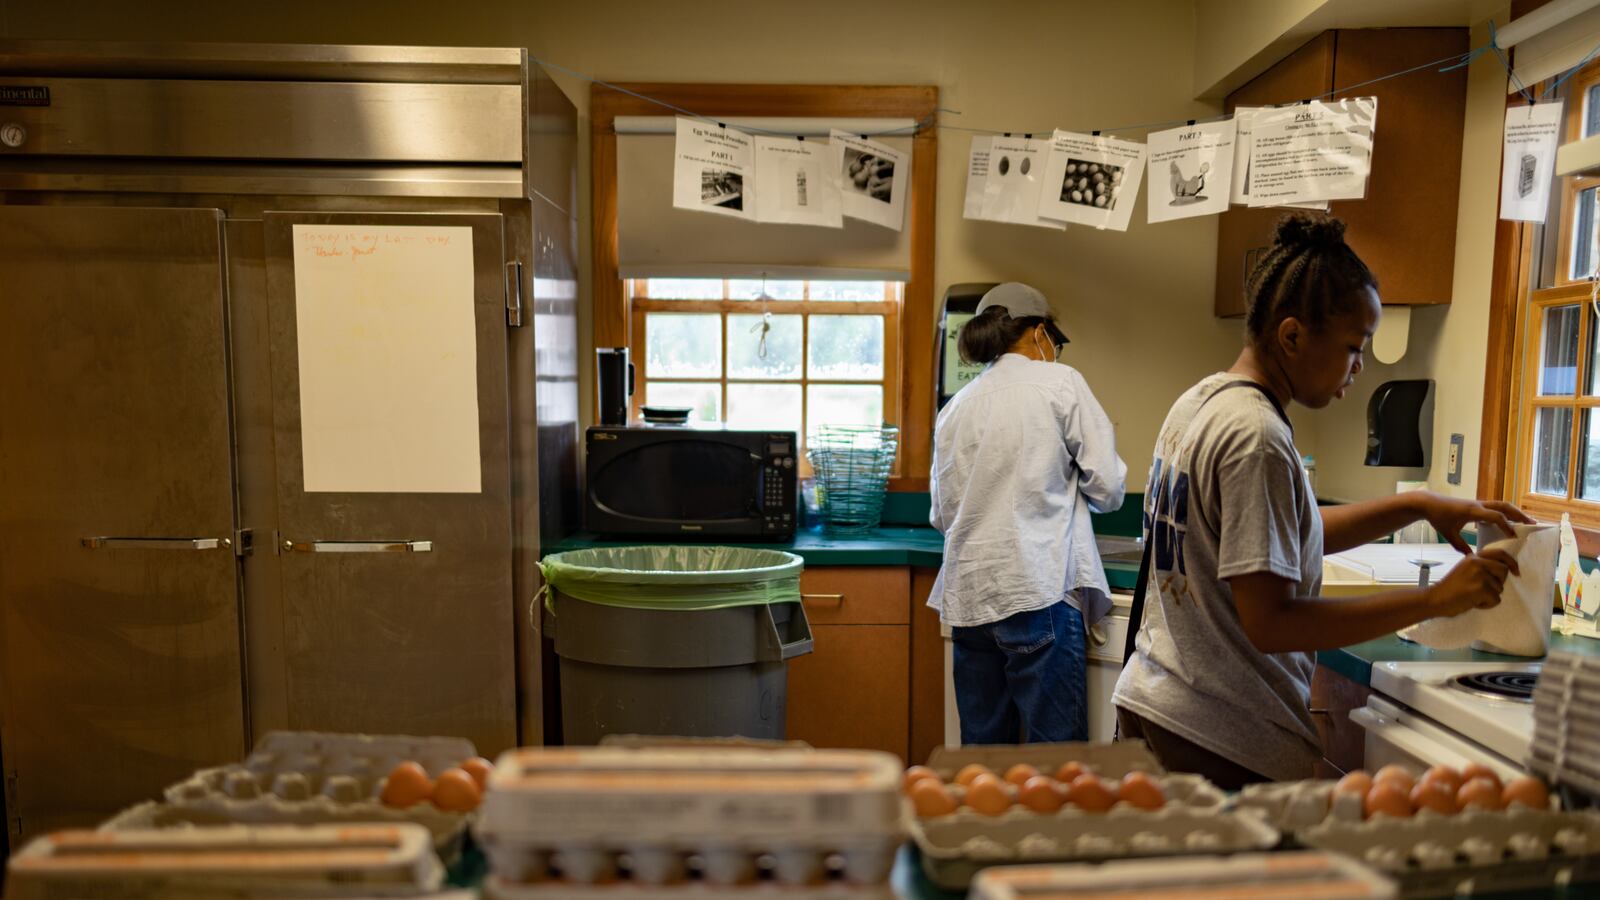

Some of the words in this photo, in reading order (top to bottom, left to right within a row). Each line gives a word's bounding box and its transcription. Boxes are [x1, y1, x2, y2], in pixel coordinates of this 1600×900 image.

[692, 128, 703, 136] Egg
[1179, 132, 1197, 141] PART
[711, 151, 728, 160] PART
